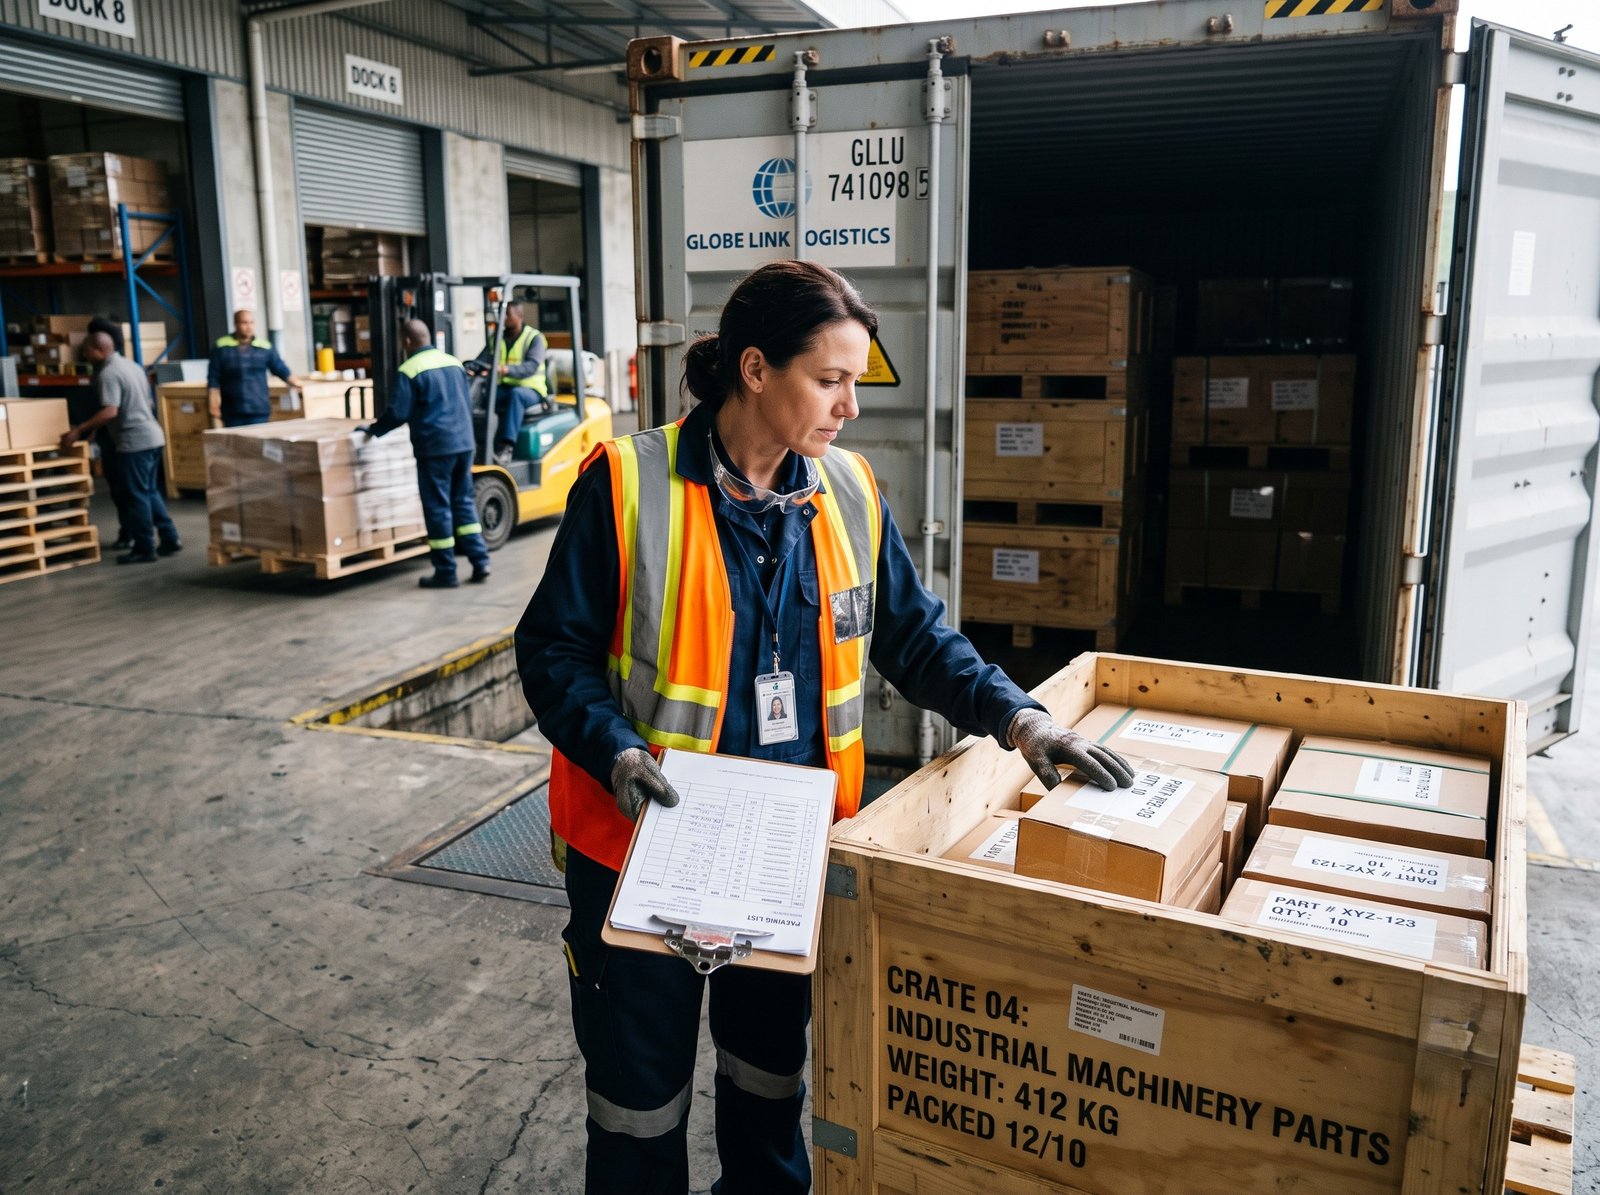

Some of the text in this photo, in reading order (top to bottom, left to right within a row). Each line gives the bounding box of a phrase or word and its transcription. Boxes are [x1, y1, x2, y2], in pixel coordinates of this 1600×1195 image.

[49, 0, 126, 24] CK 8
[352, 65, 386, 92] DOCK
[851, 136, 904, 166] GLLU
[828, 171, 909, 202] 741098
[686, 227, 891, 250] GLOBE LINK OGISTICS
[1311, 858, 1376, 876] XYZ-123
[1367, 860, 1386, 868] 10
[1395, 873, 1438, 886] PART
[747, 915, 764, 923] LIST
[1272, 906, 1313, 920] QTY:
[1328, 917, 1349, 927] 10
[1275, 896, 1321, 910] PART
[1341, 908, 1416, 928] XYZ-123
[887, 965, 976, 1014] CRATE
[985, 990, 1028, 1027] 04:
[887, 1005, 1391, 1166] INDUSTRIAL MACHINERY PARTS
[887, 1044, 1119, 1136] WEIGHT: 412 KG
[887, 1083, 1087, 1168] PACKED 12/10
